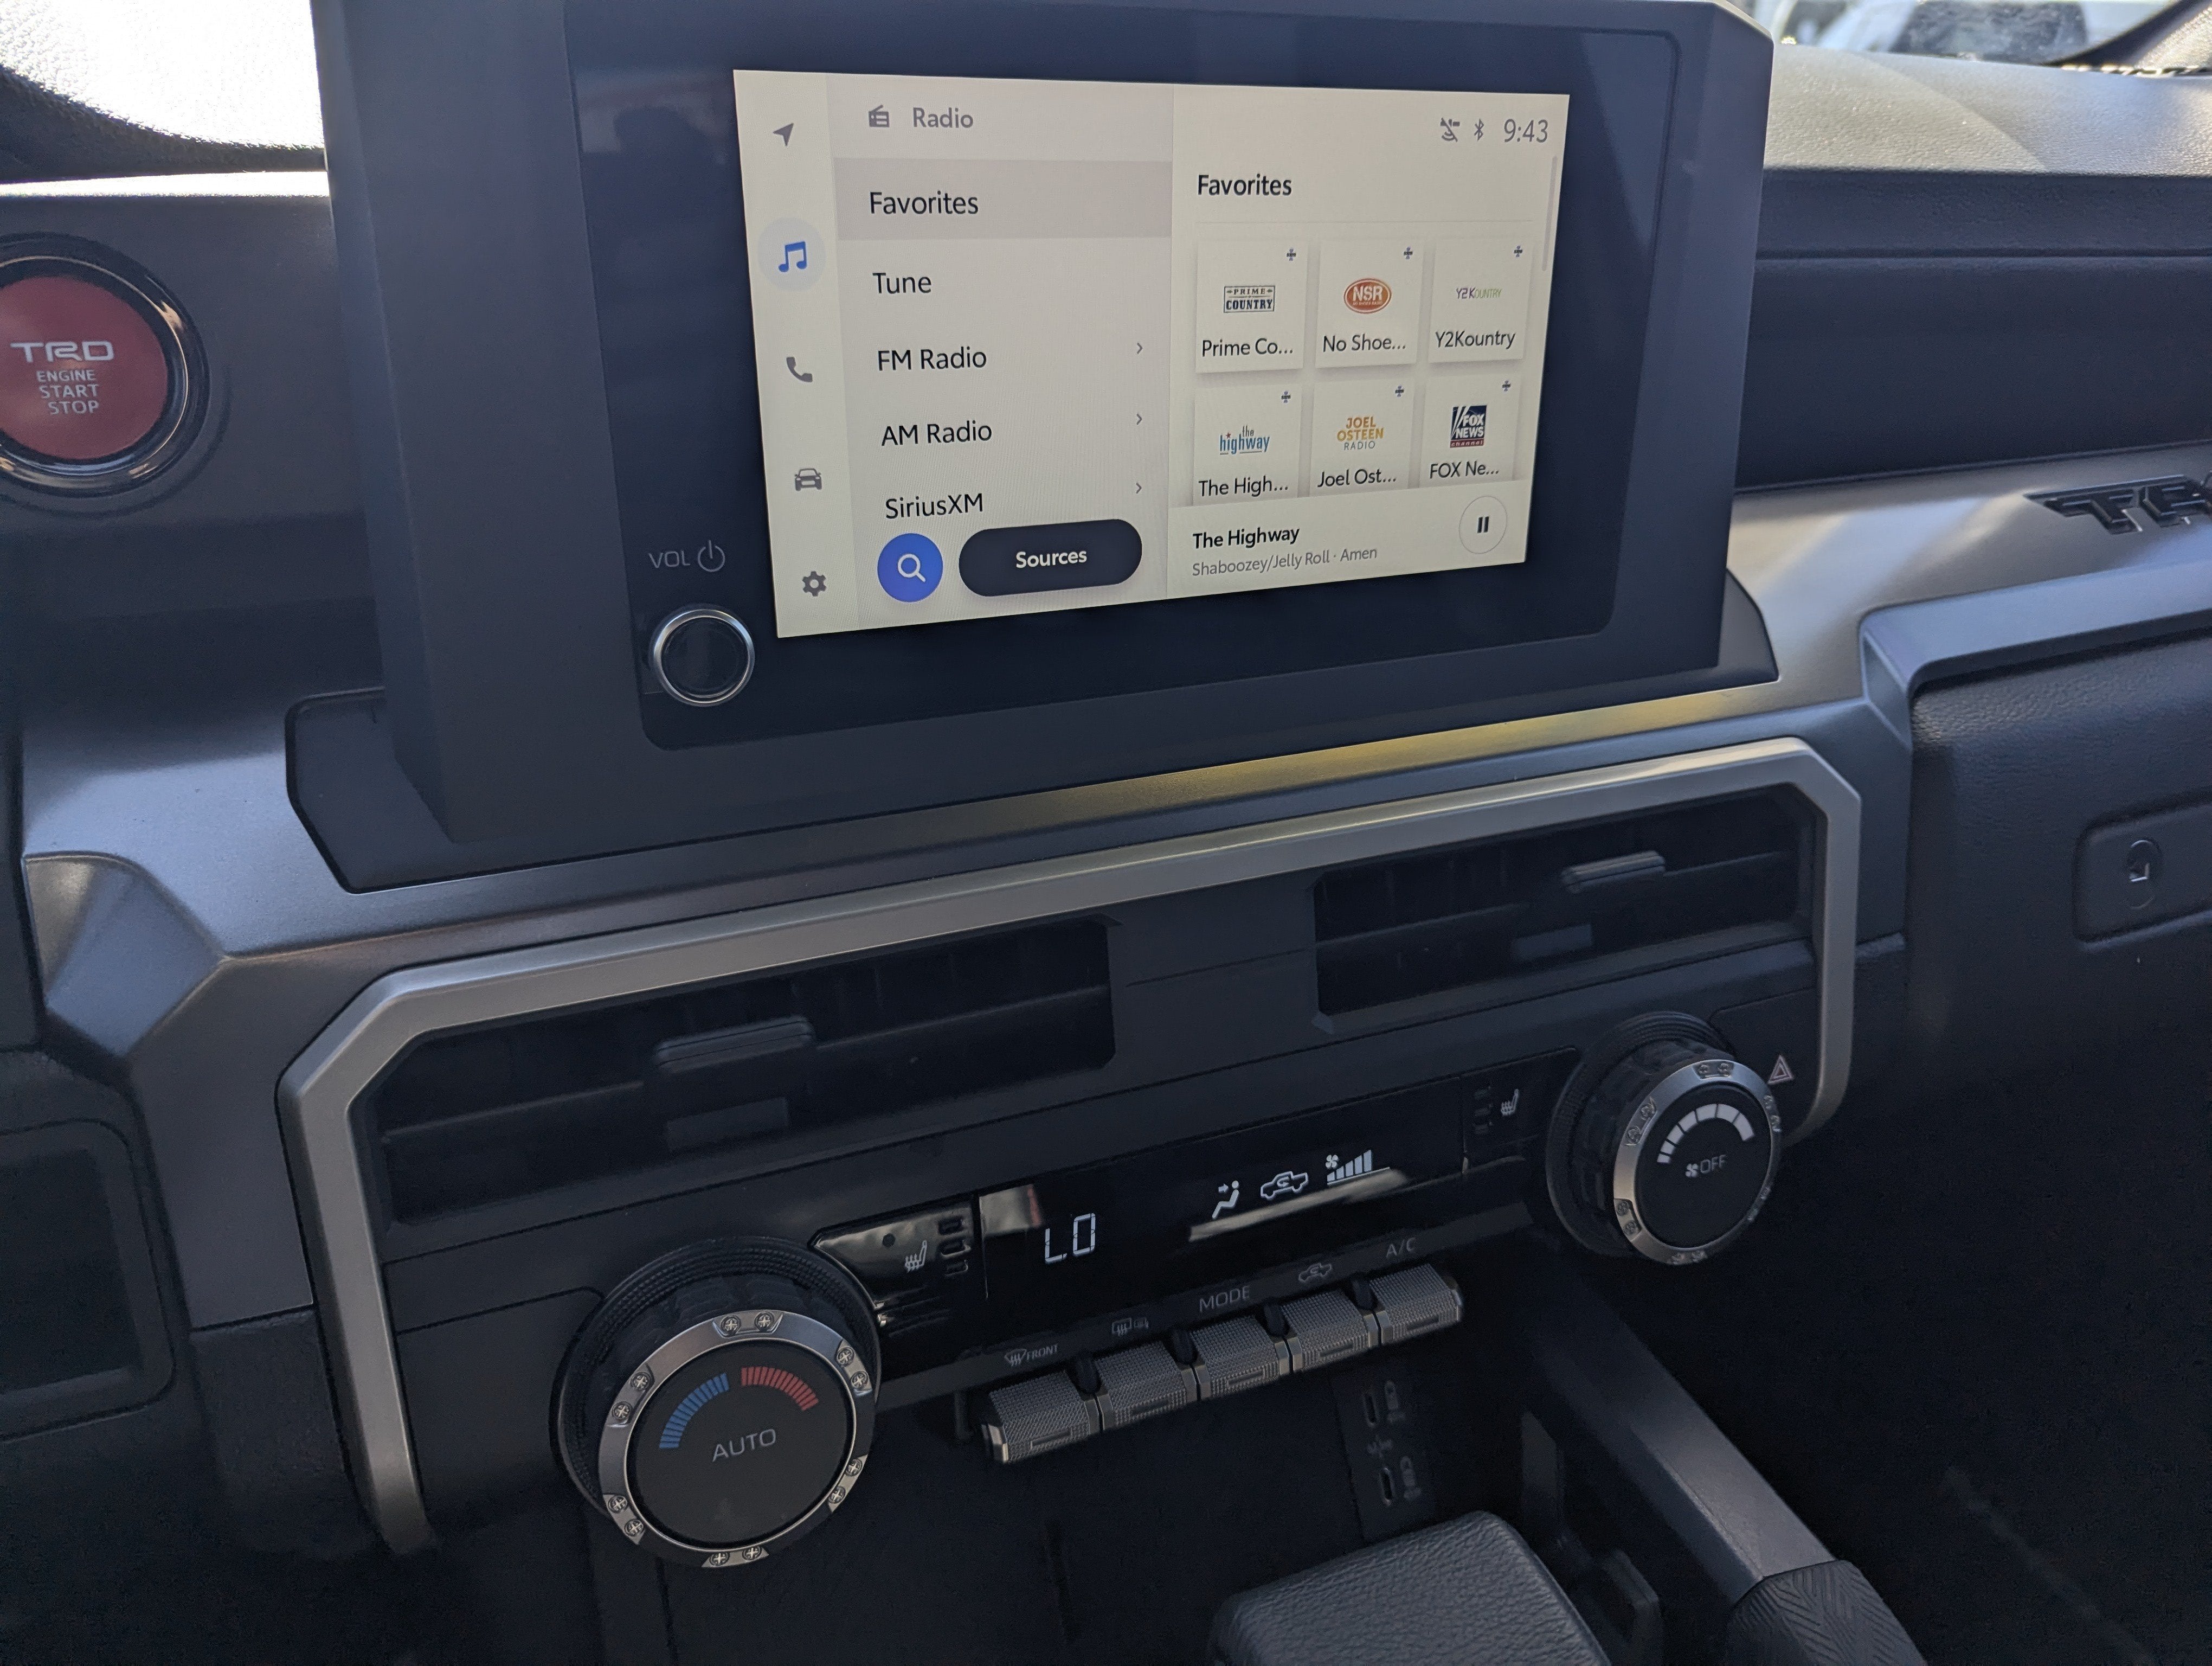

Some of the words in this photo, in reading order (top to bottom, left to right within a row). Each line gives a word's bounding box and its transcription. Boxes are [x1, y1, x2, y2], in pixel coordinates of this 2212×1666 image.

[913, 107, 974, 129] Radio
[1503, 119, 1548, 143] 9:43
[1197, 173, 1293, 196] Favorites
[869, 190, 979, 215] Favorites
[873, 272, 933, 294] Tune
[1353, 285, 1383, 302] NSR
[1226, 299, 1272, 310] COUNTRY
[1202, 339, 1250, 357] Prime
[1323, 335, 1346, 352] No
[1436, 330, 1515, 349] Y2Kountry
[10, 341, 114, 362] TRD
[878, 349, 912, 371] FM
[920, 346, 987, 369] Radio
[36, 369, 96, 382] ENGINE
[38, 383, 99, 399] START
[48, 400, 99, 415] STOP
[1346, 416, 1376, 429] JOEL
[1463, 414, 1484, 426] FOX
[881, 424, 918, 446] AM
[927, 420, 992, 444] Radio
[1242, 425, 1254, 437] the
[1337, 428, 1384, 442] OSTEEN
[1455, 426, 1484, 438] NEWS
[1220, 433, 1270, 454] highway
[1344, 441, 1375, 450] RADIO
[1317, 469, 1349, 487] Joel
[1430, 461, 1461, 478] FOX
[1198, 479, 1229, 496] The
[885, 494, 983, 519] SiriusXM
[1193, 533, 1223, 549] The
[1228, 527, 1300, 548] Highway
[648, 550, 691, 568] VOL
[1015, 549, 1087, 569] Sources
[1192, 554, 1302, 576] Shaboozey/Jelly
[1305, 550, 1329, 565] Roll
[1340, 548, 1377, 561] Amen
[1700, 1154, 1727, 1174] OFF
[1385, 1237, 1417, 1260] A/C
[1199, 1285, 1250, 1313] MODE
[1027, 1343, 1058, 1360] FRONT
[712, 1428, 777, 1462] AUTO
